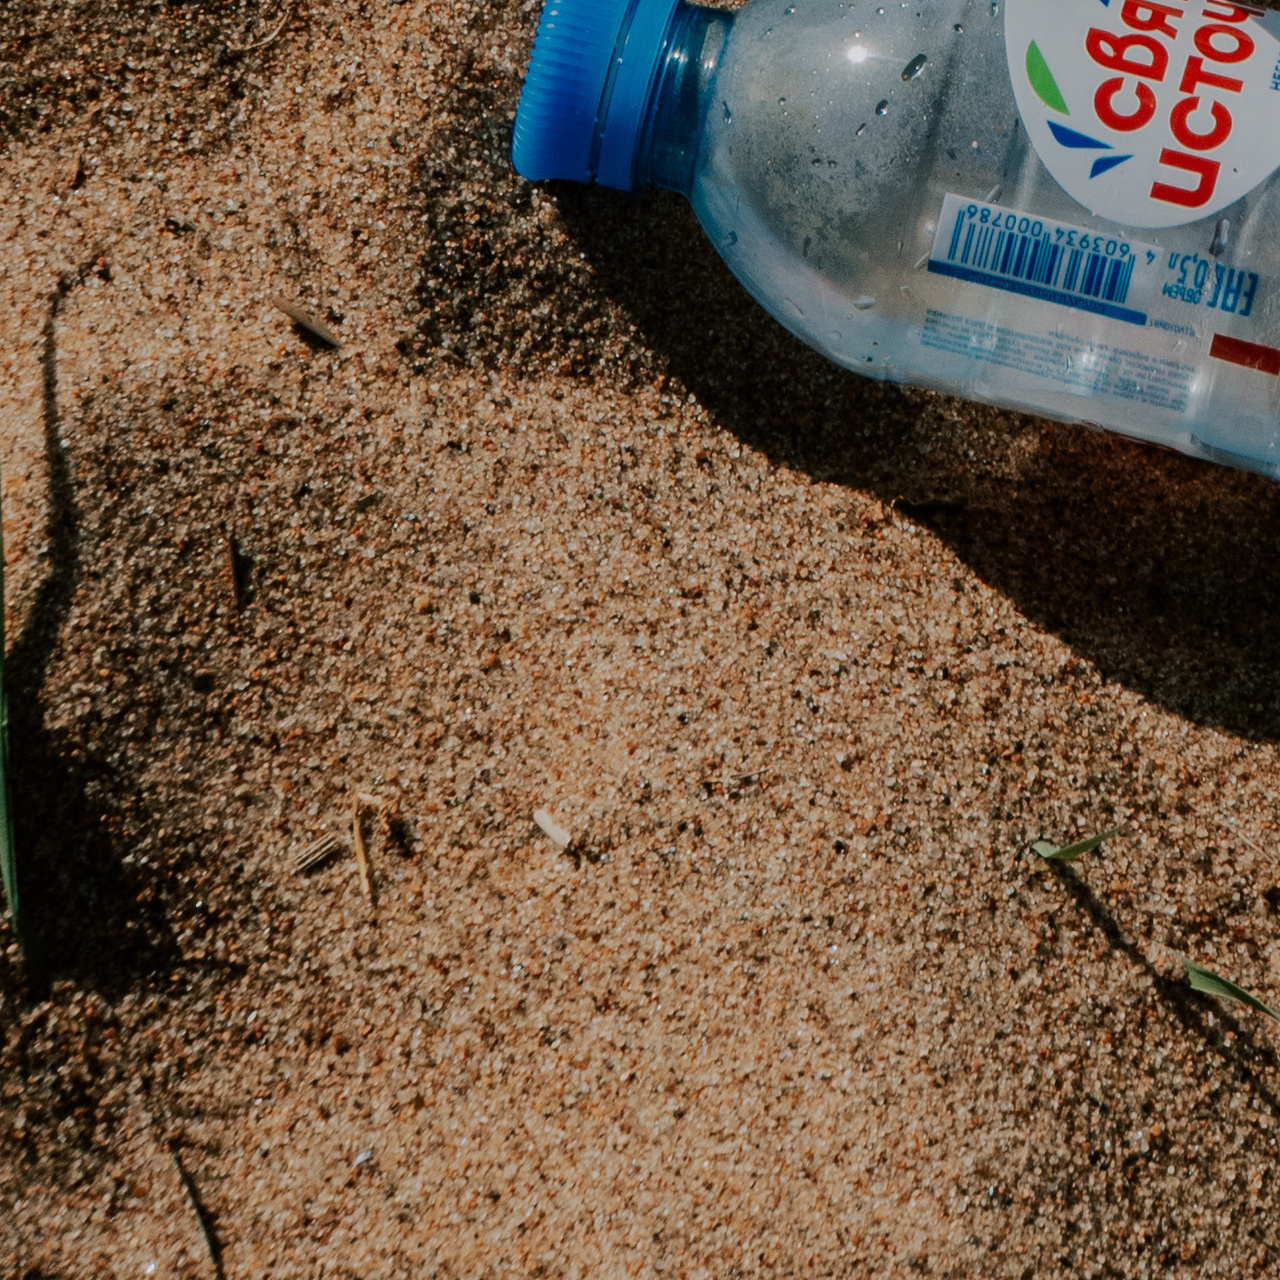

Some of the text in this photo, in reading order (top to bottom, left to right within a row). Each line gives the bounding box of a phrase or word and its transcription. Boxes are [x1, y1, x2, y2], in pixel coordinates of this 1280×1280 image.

[966, 203, 1044, 238] 000786
[1055, 226, 1131, 259] 603934
[1162, 282, 1202, 306] ОБЪЕМ
